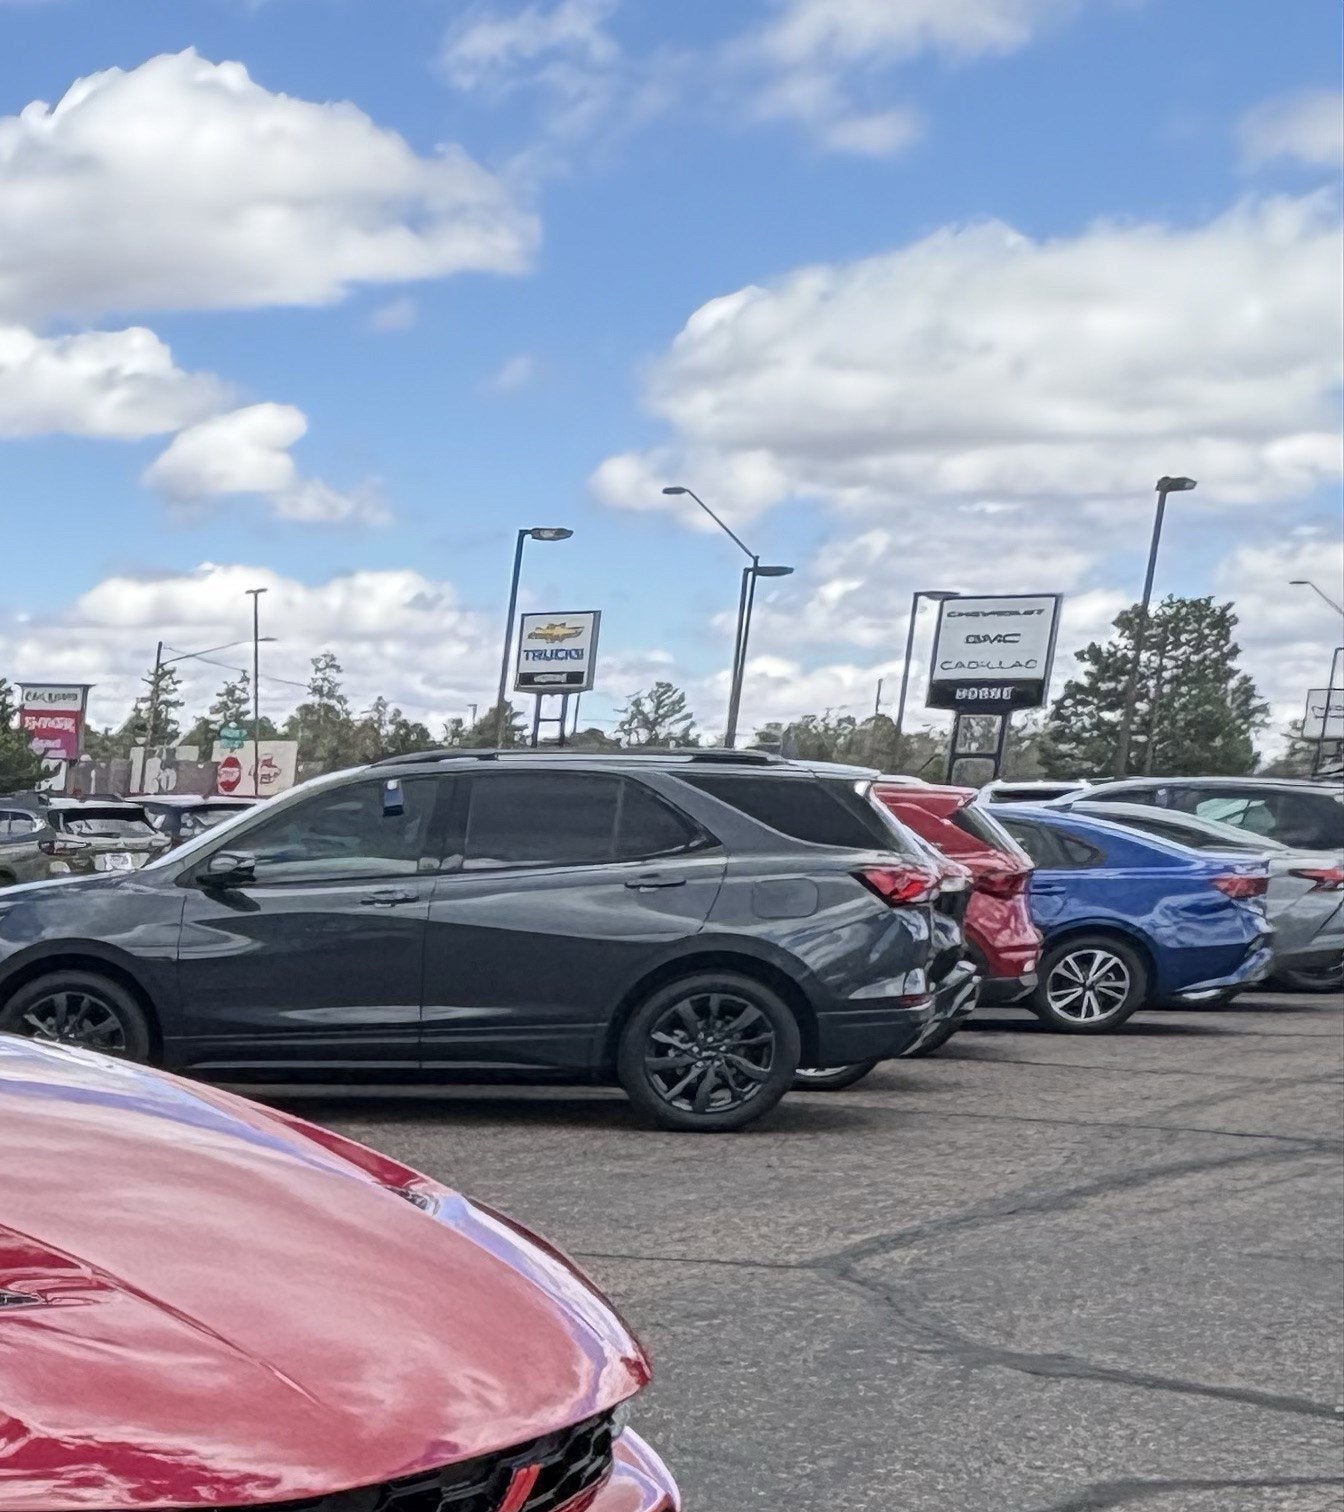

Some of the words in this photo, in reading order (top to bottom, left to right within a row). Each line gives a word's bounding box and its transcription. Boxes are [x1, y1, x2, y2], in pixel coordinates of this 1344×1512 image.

[946, 608, 1045, 618] CHEVROLET
[964, 632, 1022, 645] GMC
[940, 659, 1038, 671] CADILLAC
